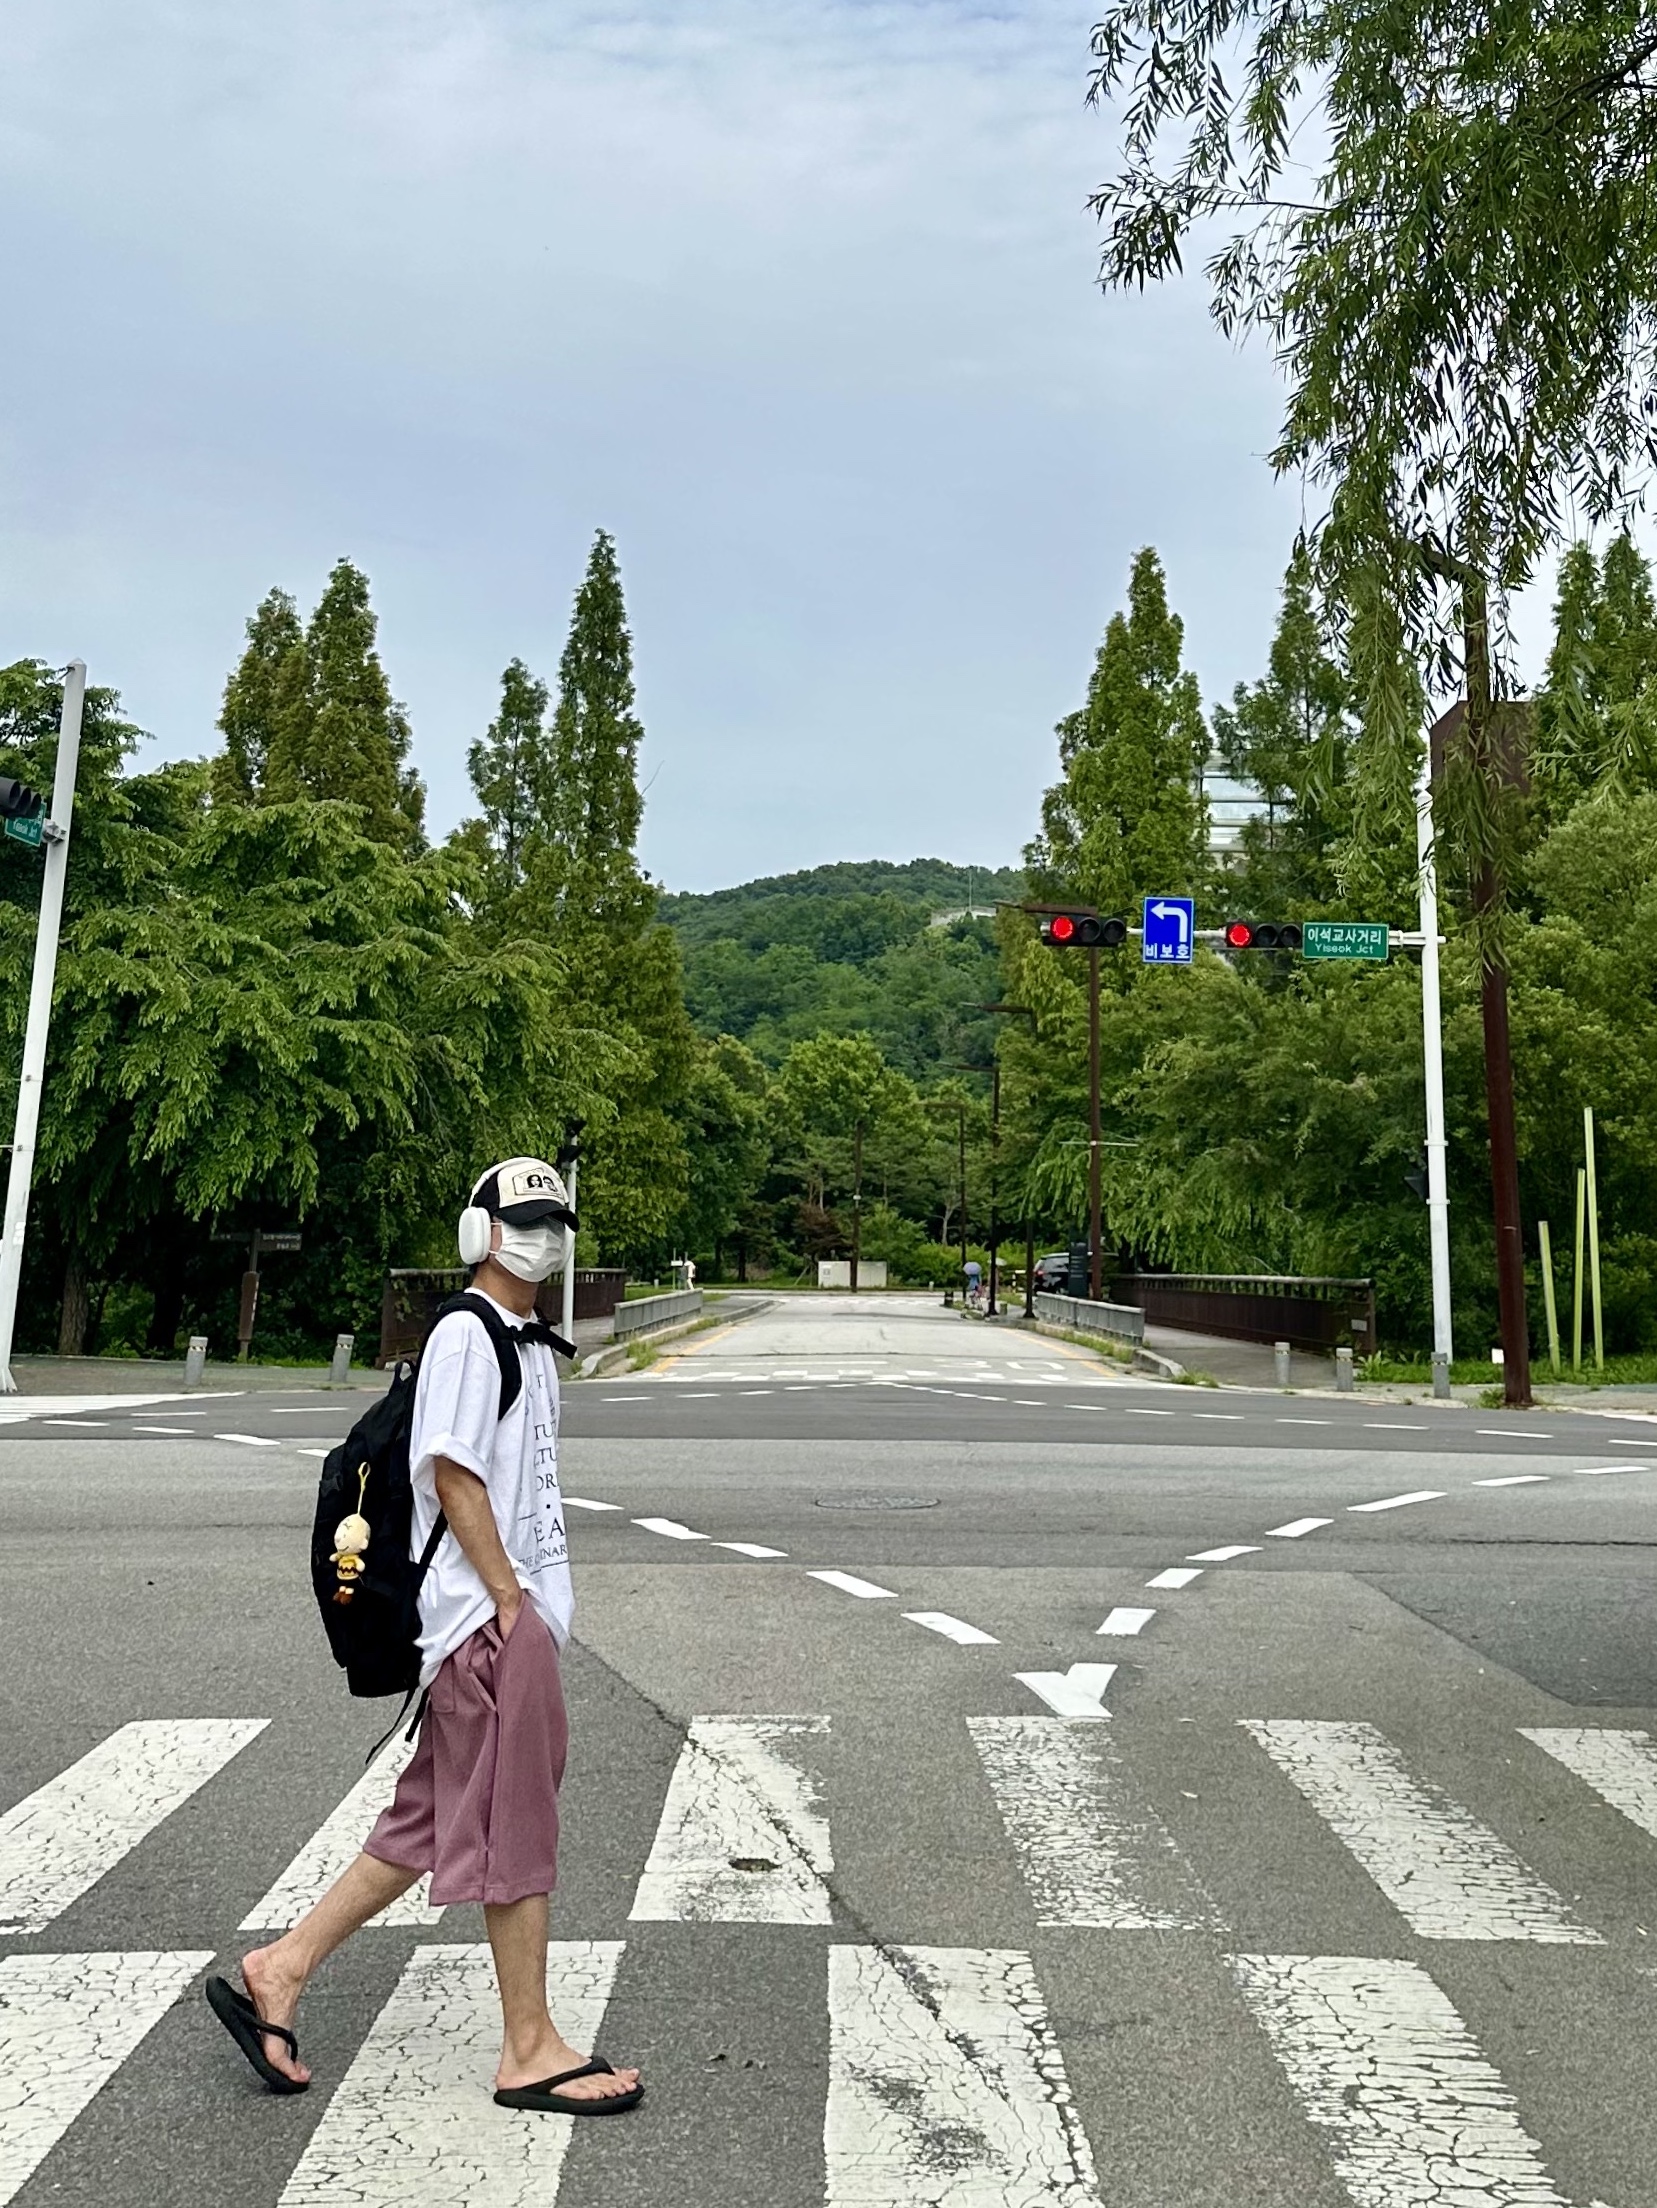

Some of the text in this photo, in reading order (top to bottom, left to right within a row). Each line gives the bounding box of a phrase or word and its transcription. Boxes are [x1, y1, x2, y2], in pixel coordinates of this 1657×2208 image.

[1307, 927, 1382, 945] 이석교사거리
[1145, 942, 1190, 959] 비보호
[1356, 944, 1374, 954] Jct
